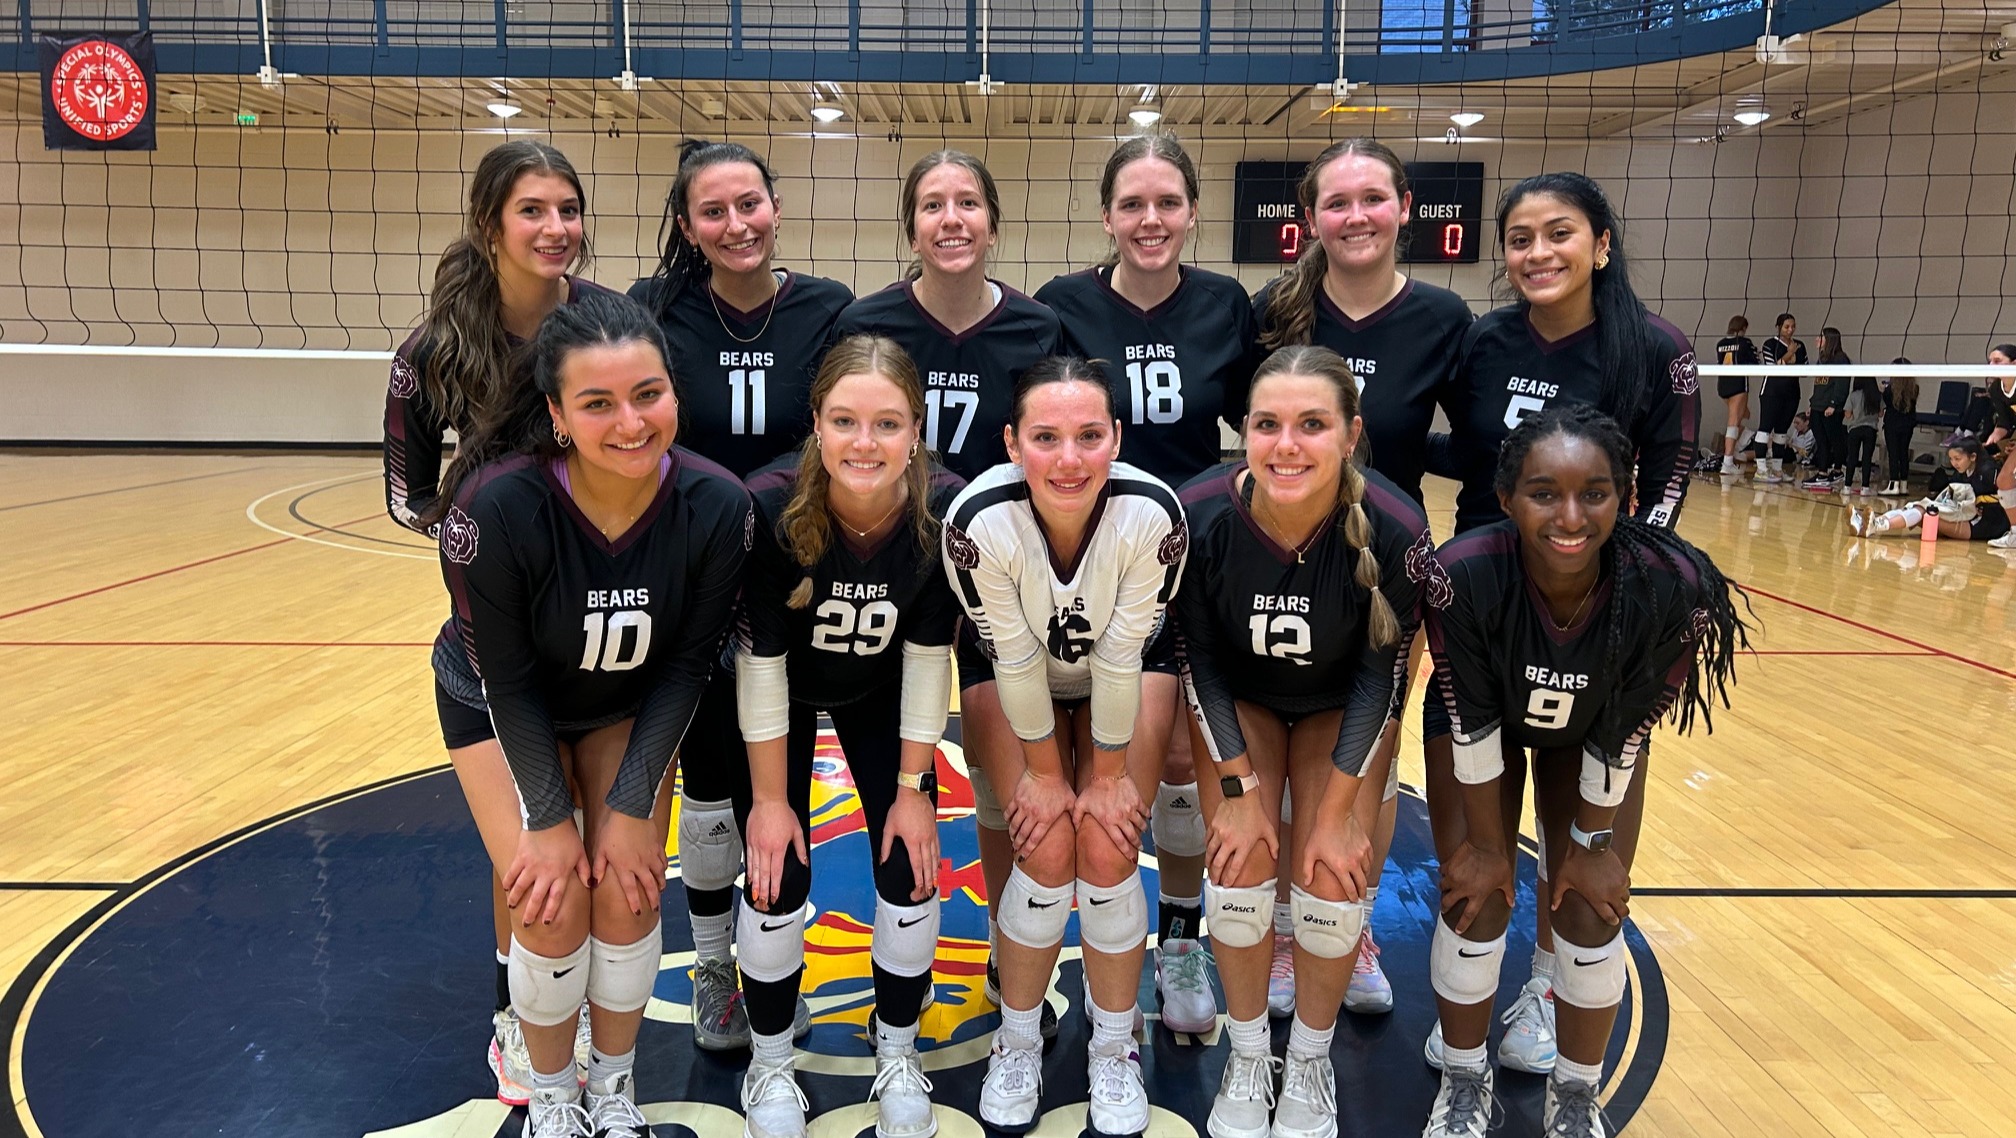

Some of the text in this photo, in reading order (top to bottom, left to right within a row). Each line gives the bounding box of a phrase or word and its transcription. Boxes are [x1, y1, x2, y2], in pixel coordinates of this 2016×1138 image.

[56, 45, 142, 90] SPECIAL OLYMPICS
[58, 97, 143, 136] UNIFIED SPORTS
[1257, 203, 1296, 218] HOME
[1419, 204, 1463, 218] GUEST
[1444, 223, 1463, 255] 0
[719, 351, 774, 367] BEARS
[1126, 344, 1176, 360] BEARS
[1341, 357, 1377, 374] ARS
[928, 371, 979, 388] BEARS
[1126, 361, 1183, 424] 18
[1507, 376, 1559, 398] BEARS
[728, 369, 765, 435] 11
[925, 389, 980, 454] 17
[587, 588, 649, 608] BEARS
[832, 582, 888, 599] BEARS
[1253, 594, 1310, 613] BEARS
[579, 610, 652, 672] 10
[811, 600, 898, 656] 29
[1249, 614, 1313, 666] 12
[1525, 664, 1589, 690] BEARS
[1524, 688, 1575, 730] 9
